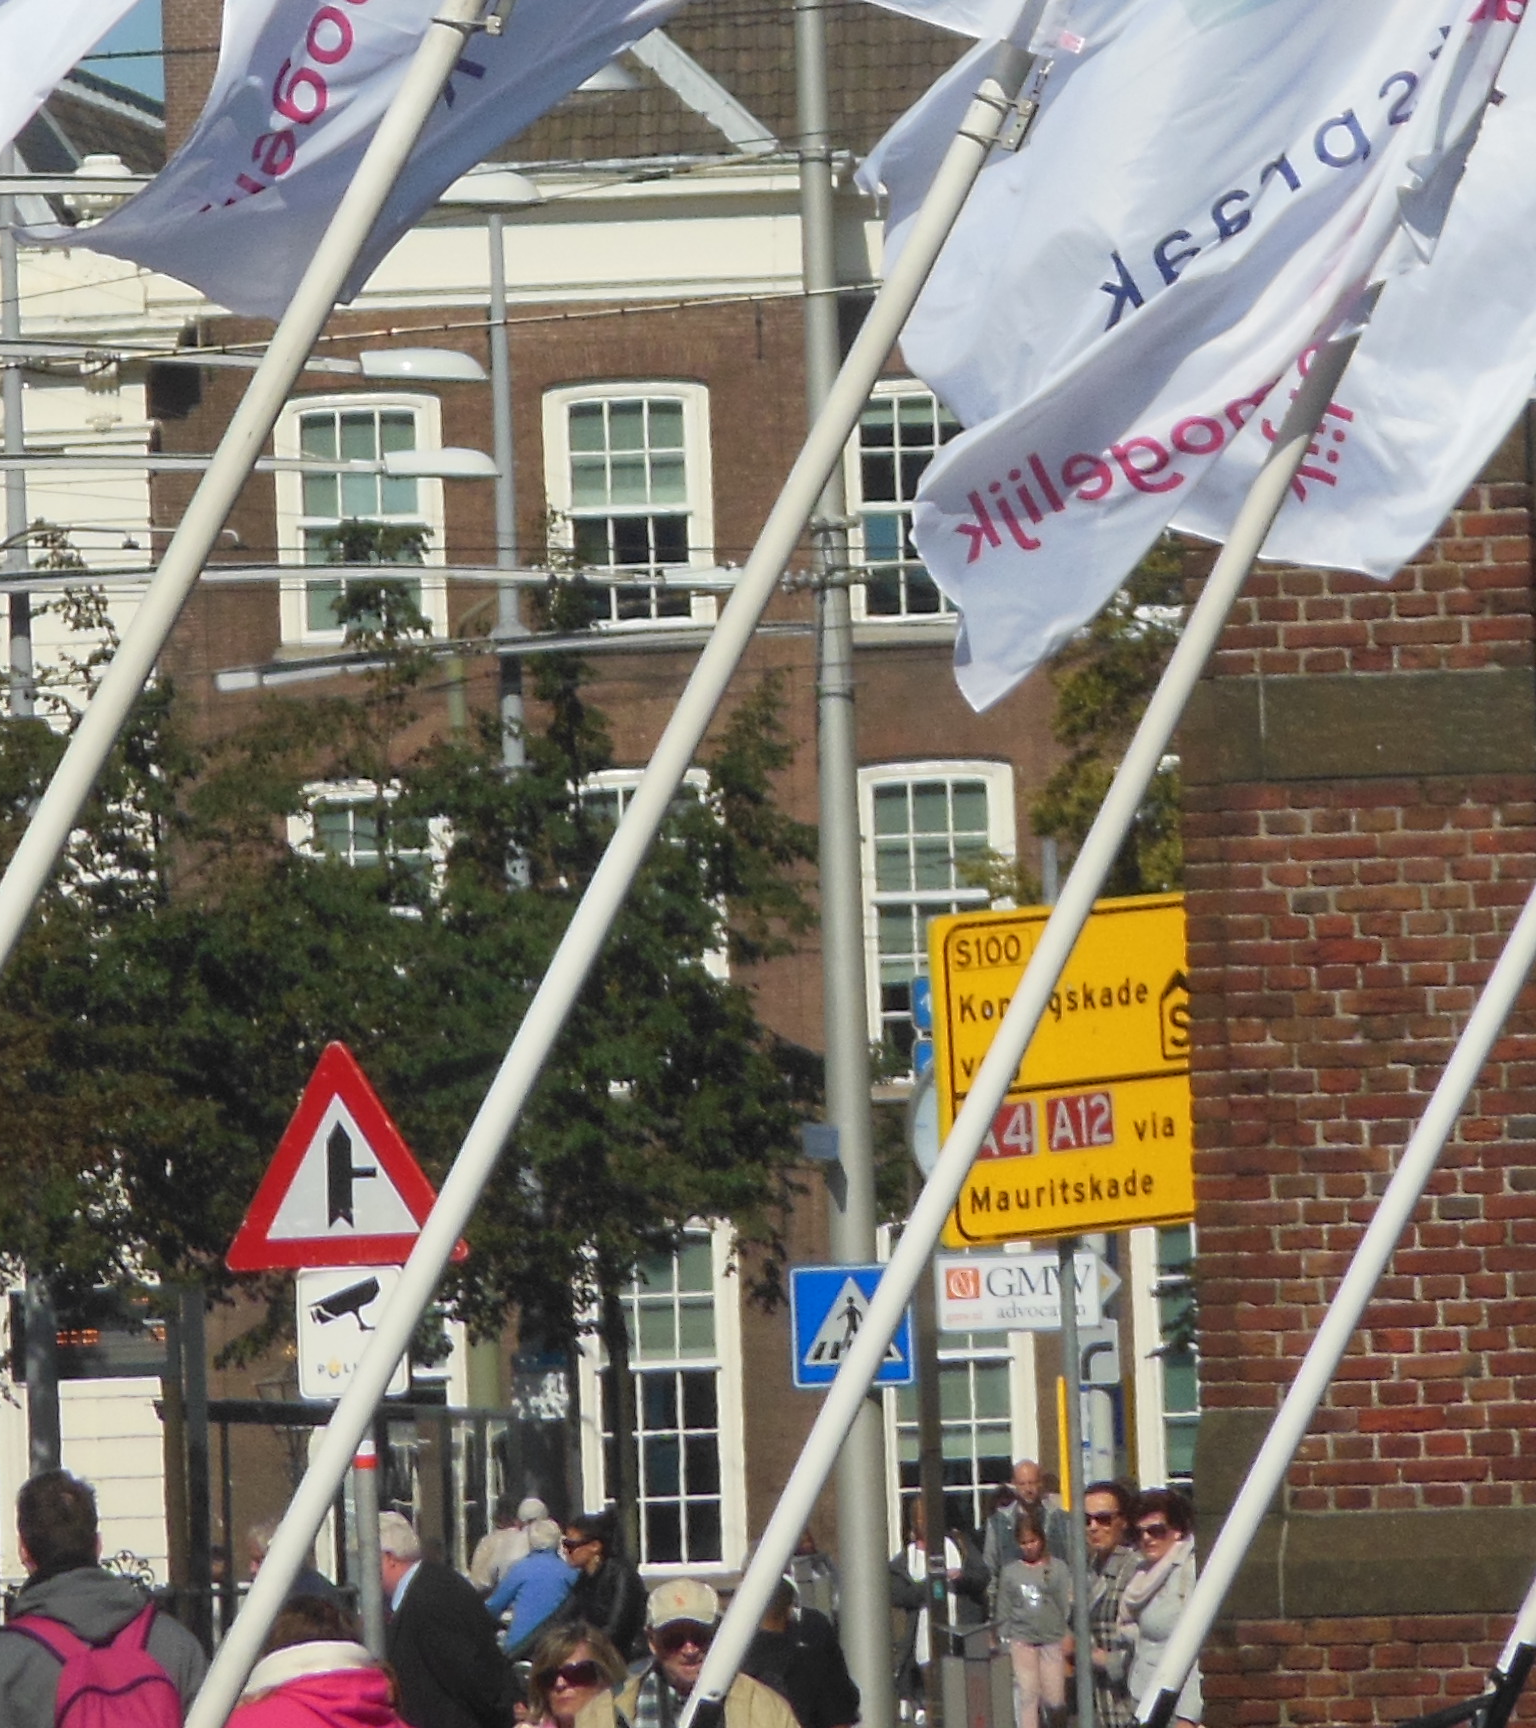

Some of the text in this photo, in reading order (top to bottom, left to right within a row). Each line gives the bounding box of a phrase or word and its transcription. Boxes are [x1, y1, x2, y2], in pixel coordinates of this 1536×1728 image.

[955, 934, 1021, 968] S100
[958, 976, 1149, 1024] Kongskade
[1052, 1093, 1114, 1148] A12
[1132, 1111, 1176, 1142] via
[969, 1169, 1155, 1215] Mauritskade
